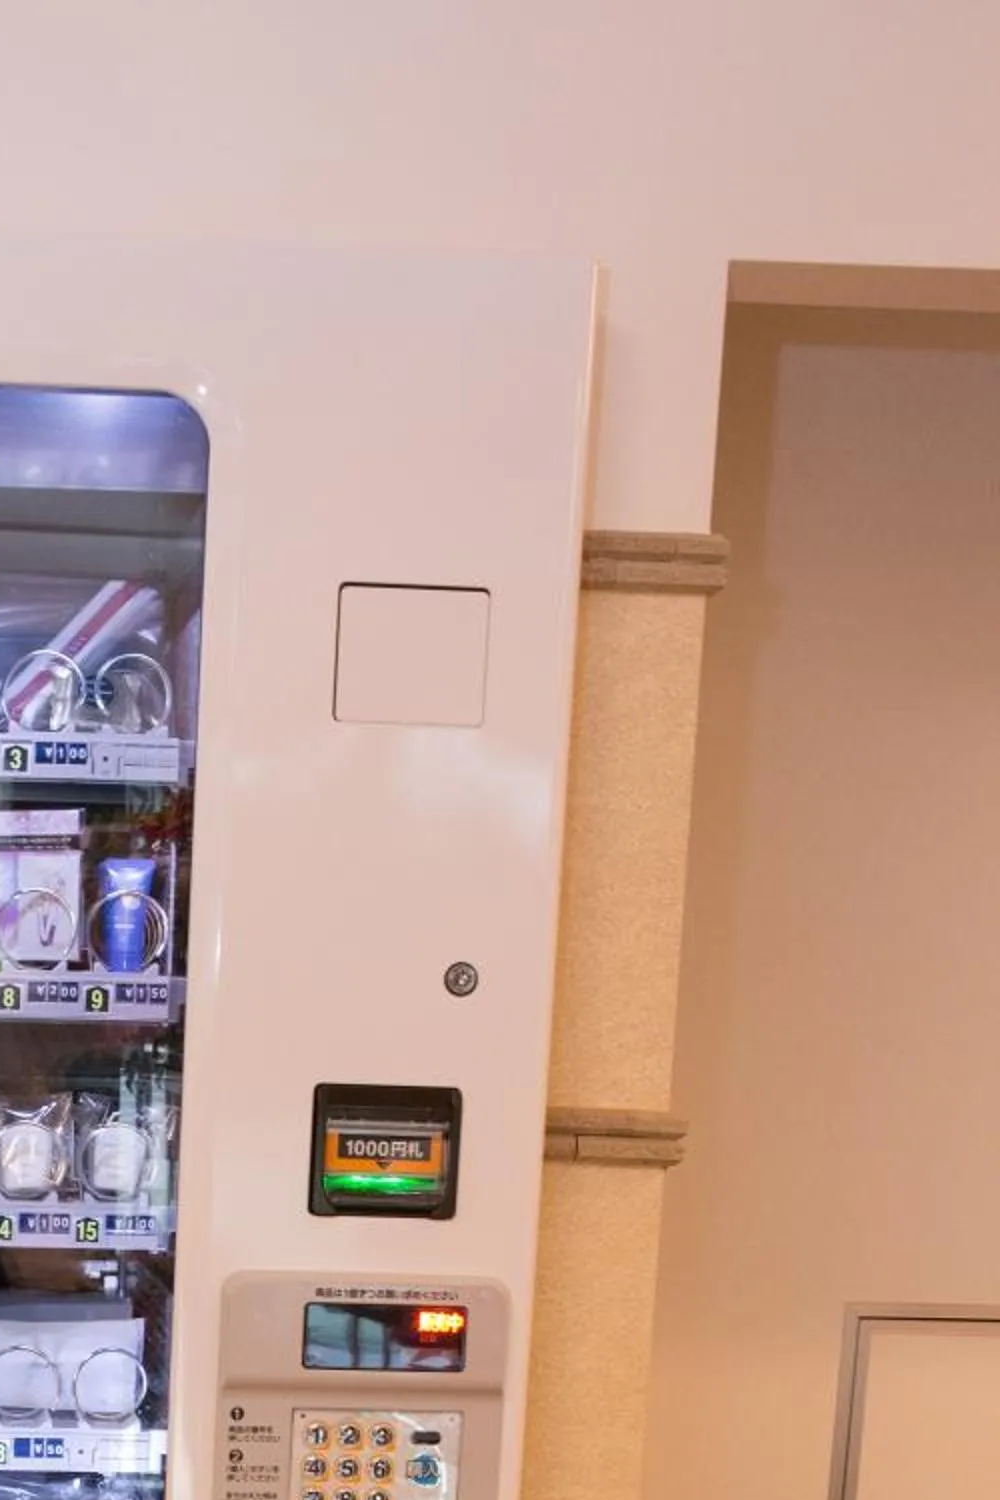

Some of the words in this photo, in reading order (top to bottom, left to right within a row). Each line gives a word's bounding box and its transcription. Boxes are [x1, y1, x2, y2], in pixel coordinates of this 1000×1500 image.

[9, 748, 23, 769] 3
[3, 987, 15, 1007] 8
[91, 989, 103, 1009] 9
[346, 1139, 424, 1159] 1000円札
[76, 1221, 98, 1242] 15
